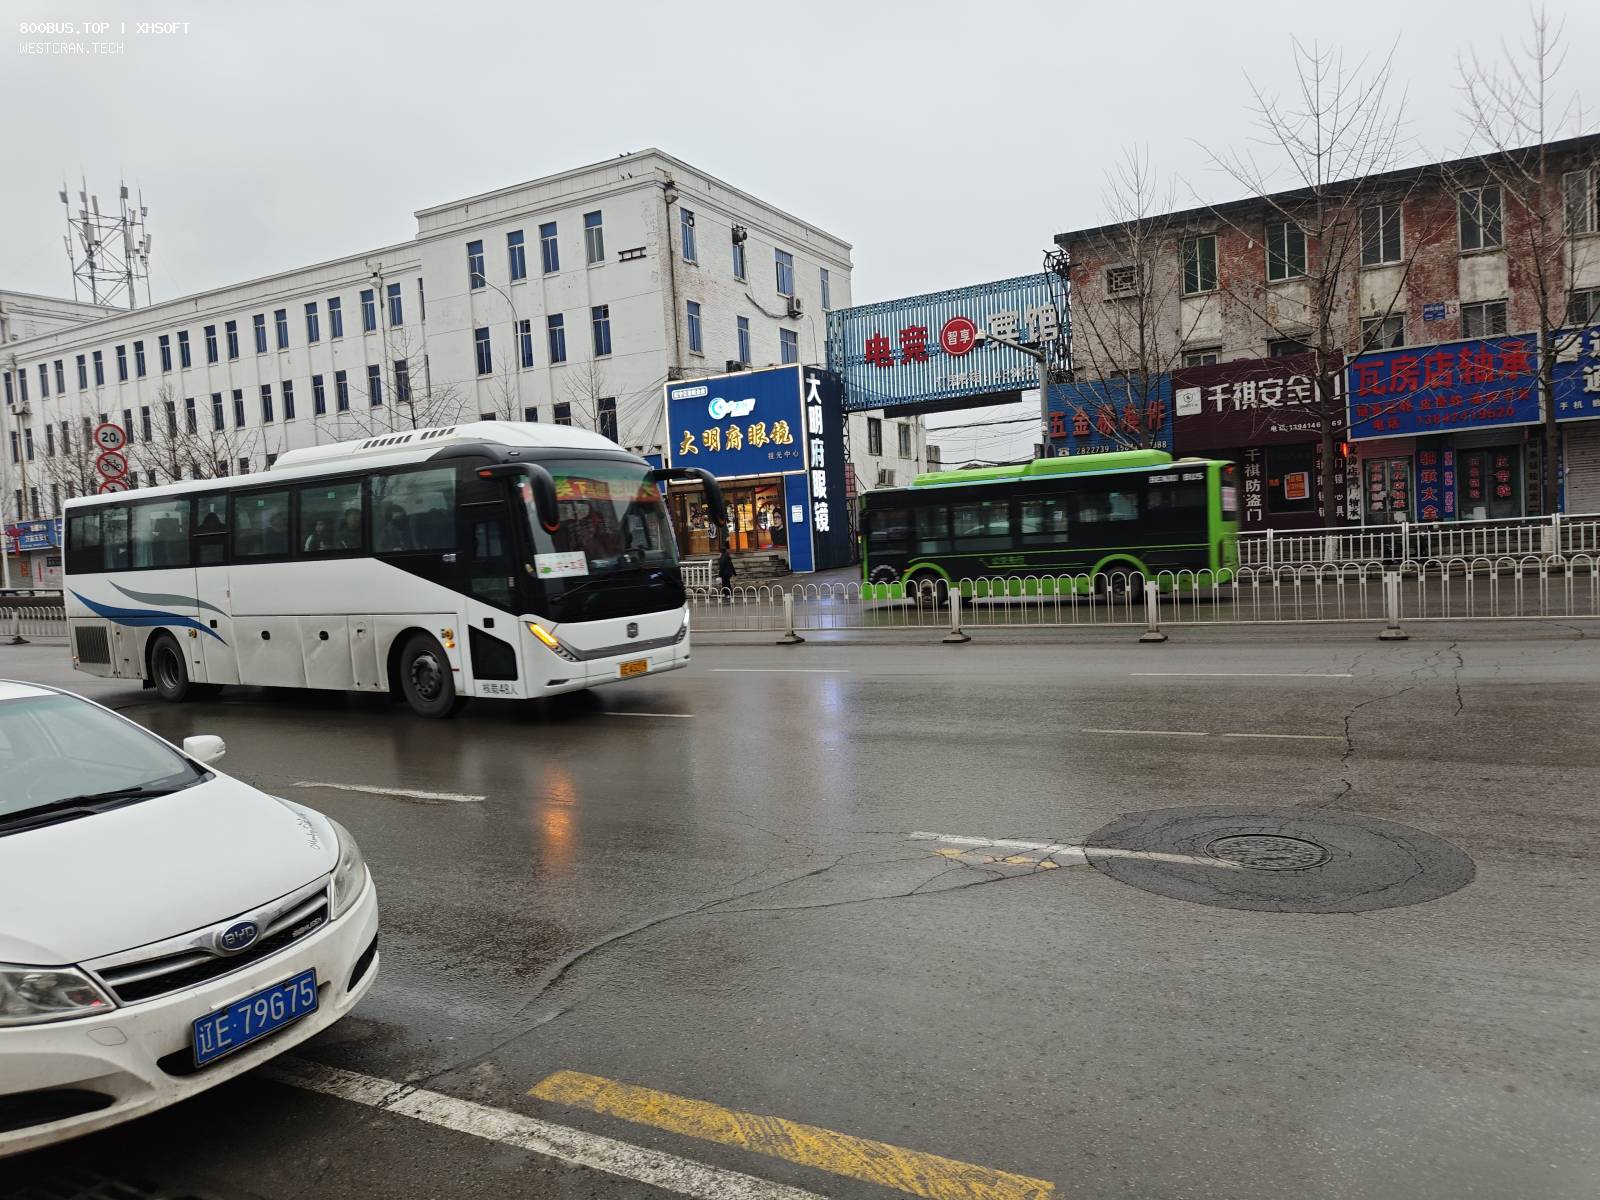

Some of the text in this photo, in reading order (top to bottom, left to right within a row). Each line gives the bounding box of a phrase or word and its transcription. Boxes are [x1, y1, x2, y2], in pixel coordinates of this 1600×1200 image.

[864, 301, 1059, 368] 电竞 智享 宾馆
[1207, 370, 1341, 413] 千祺安全门
[1352, 339, 1535, 397] 瓦房店轴承
[679, 420, 794, 456] 大明府眼镜
[806, 373, 830, 533] 大明府眼镜
[1182, 472, 1205, 481] BUS
[1244, 448, 1262, 522] 千祺防盗门
[225, 925, 254, 944] BYD
